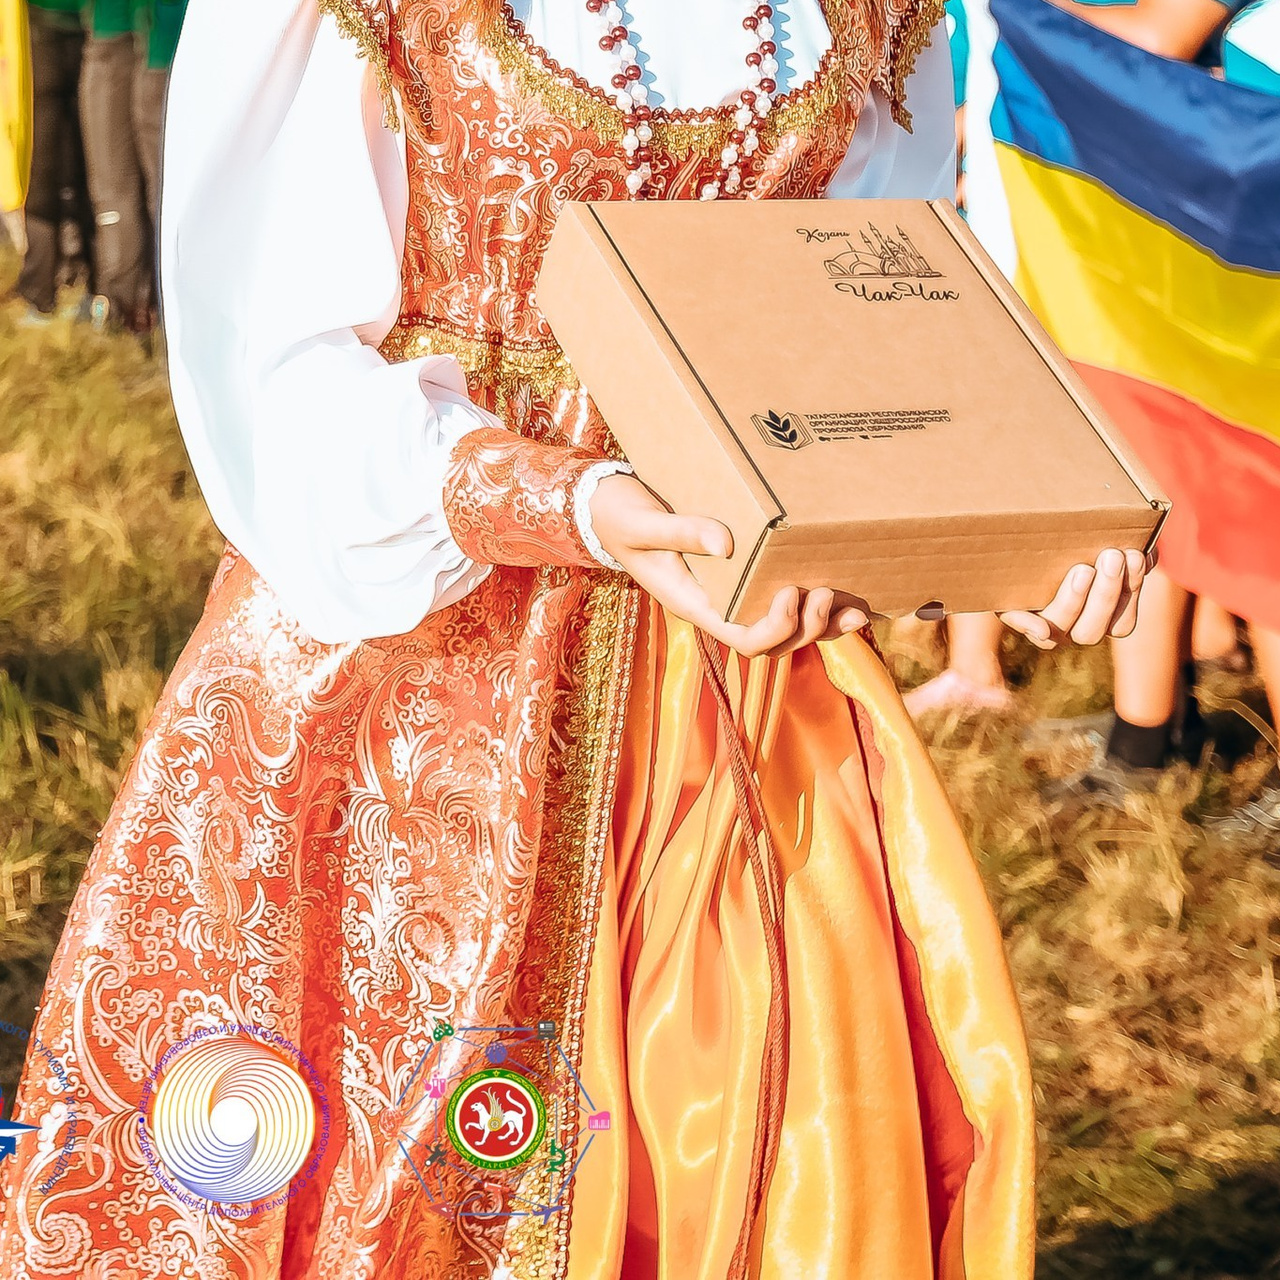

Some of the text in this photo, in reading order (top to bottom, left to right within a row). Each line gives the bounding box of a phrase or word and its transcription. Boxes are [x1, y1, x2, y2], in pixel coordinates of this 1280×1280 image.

[796, 228, 850, 243] Казань
[835, 281, 960, 302] Чак-Чак
[803, 412, 870, 420] ТАТАРСТАНСКАЯ
[867, 424, 926, 432] ОБРАЗОВАНИЯ
